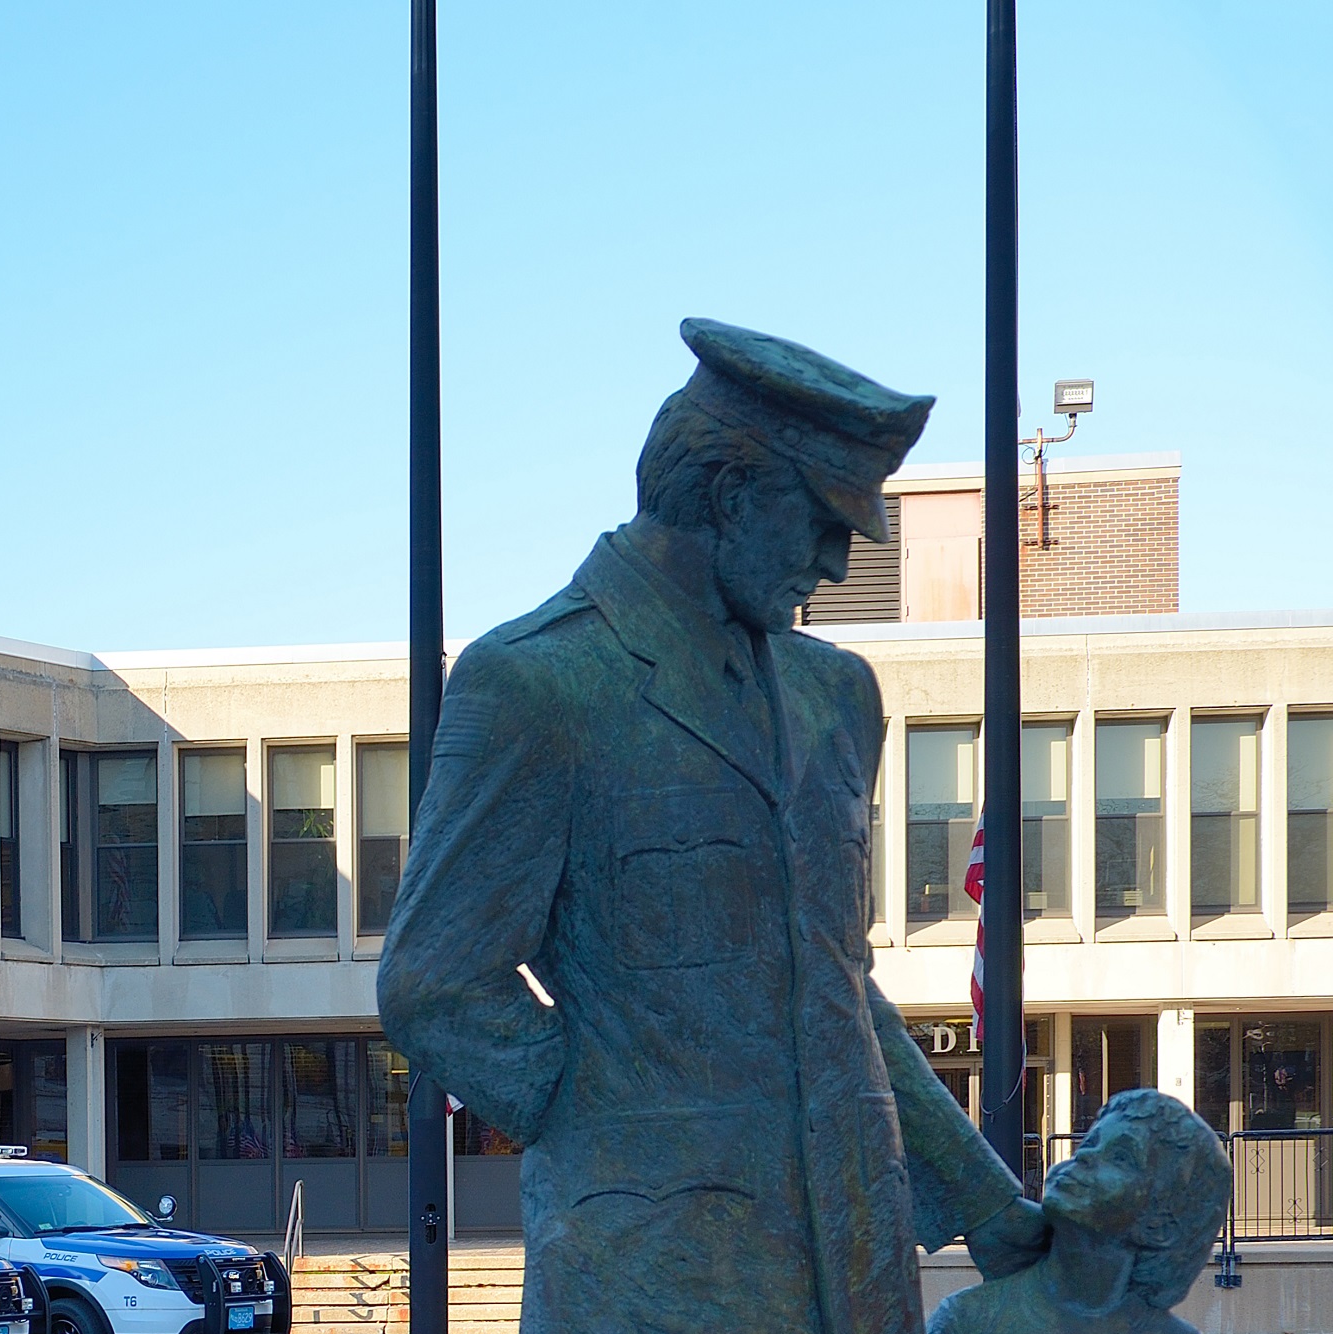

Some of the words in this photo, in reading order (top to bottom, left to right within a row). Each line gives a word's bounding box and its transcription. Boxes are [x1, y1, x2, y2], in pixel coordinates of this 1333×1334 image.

[43, 1252, 78, 1263] POLICE
[204, 1248, 237, 1256] POLICE
[123, 1296, 138, 1307] T6
